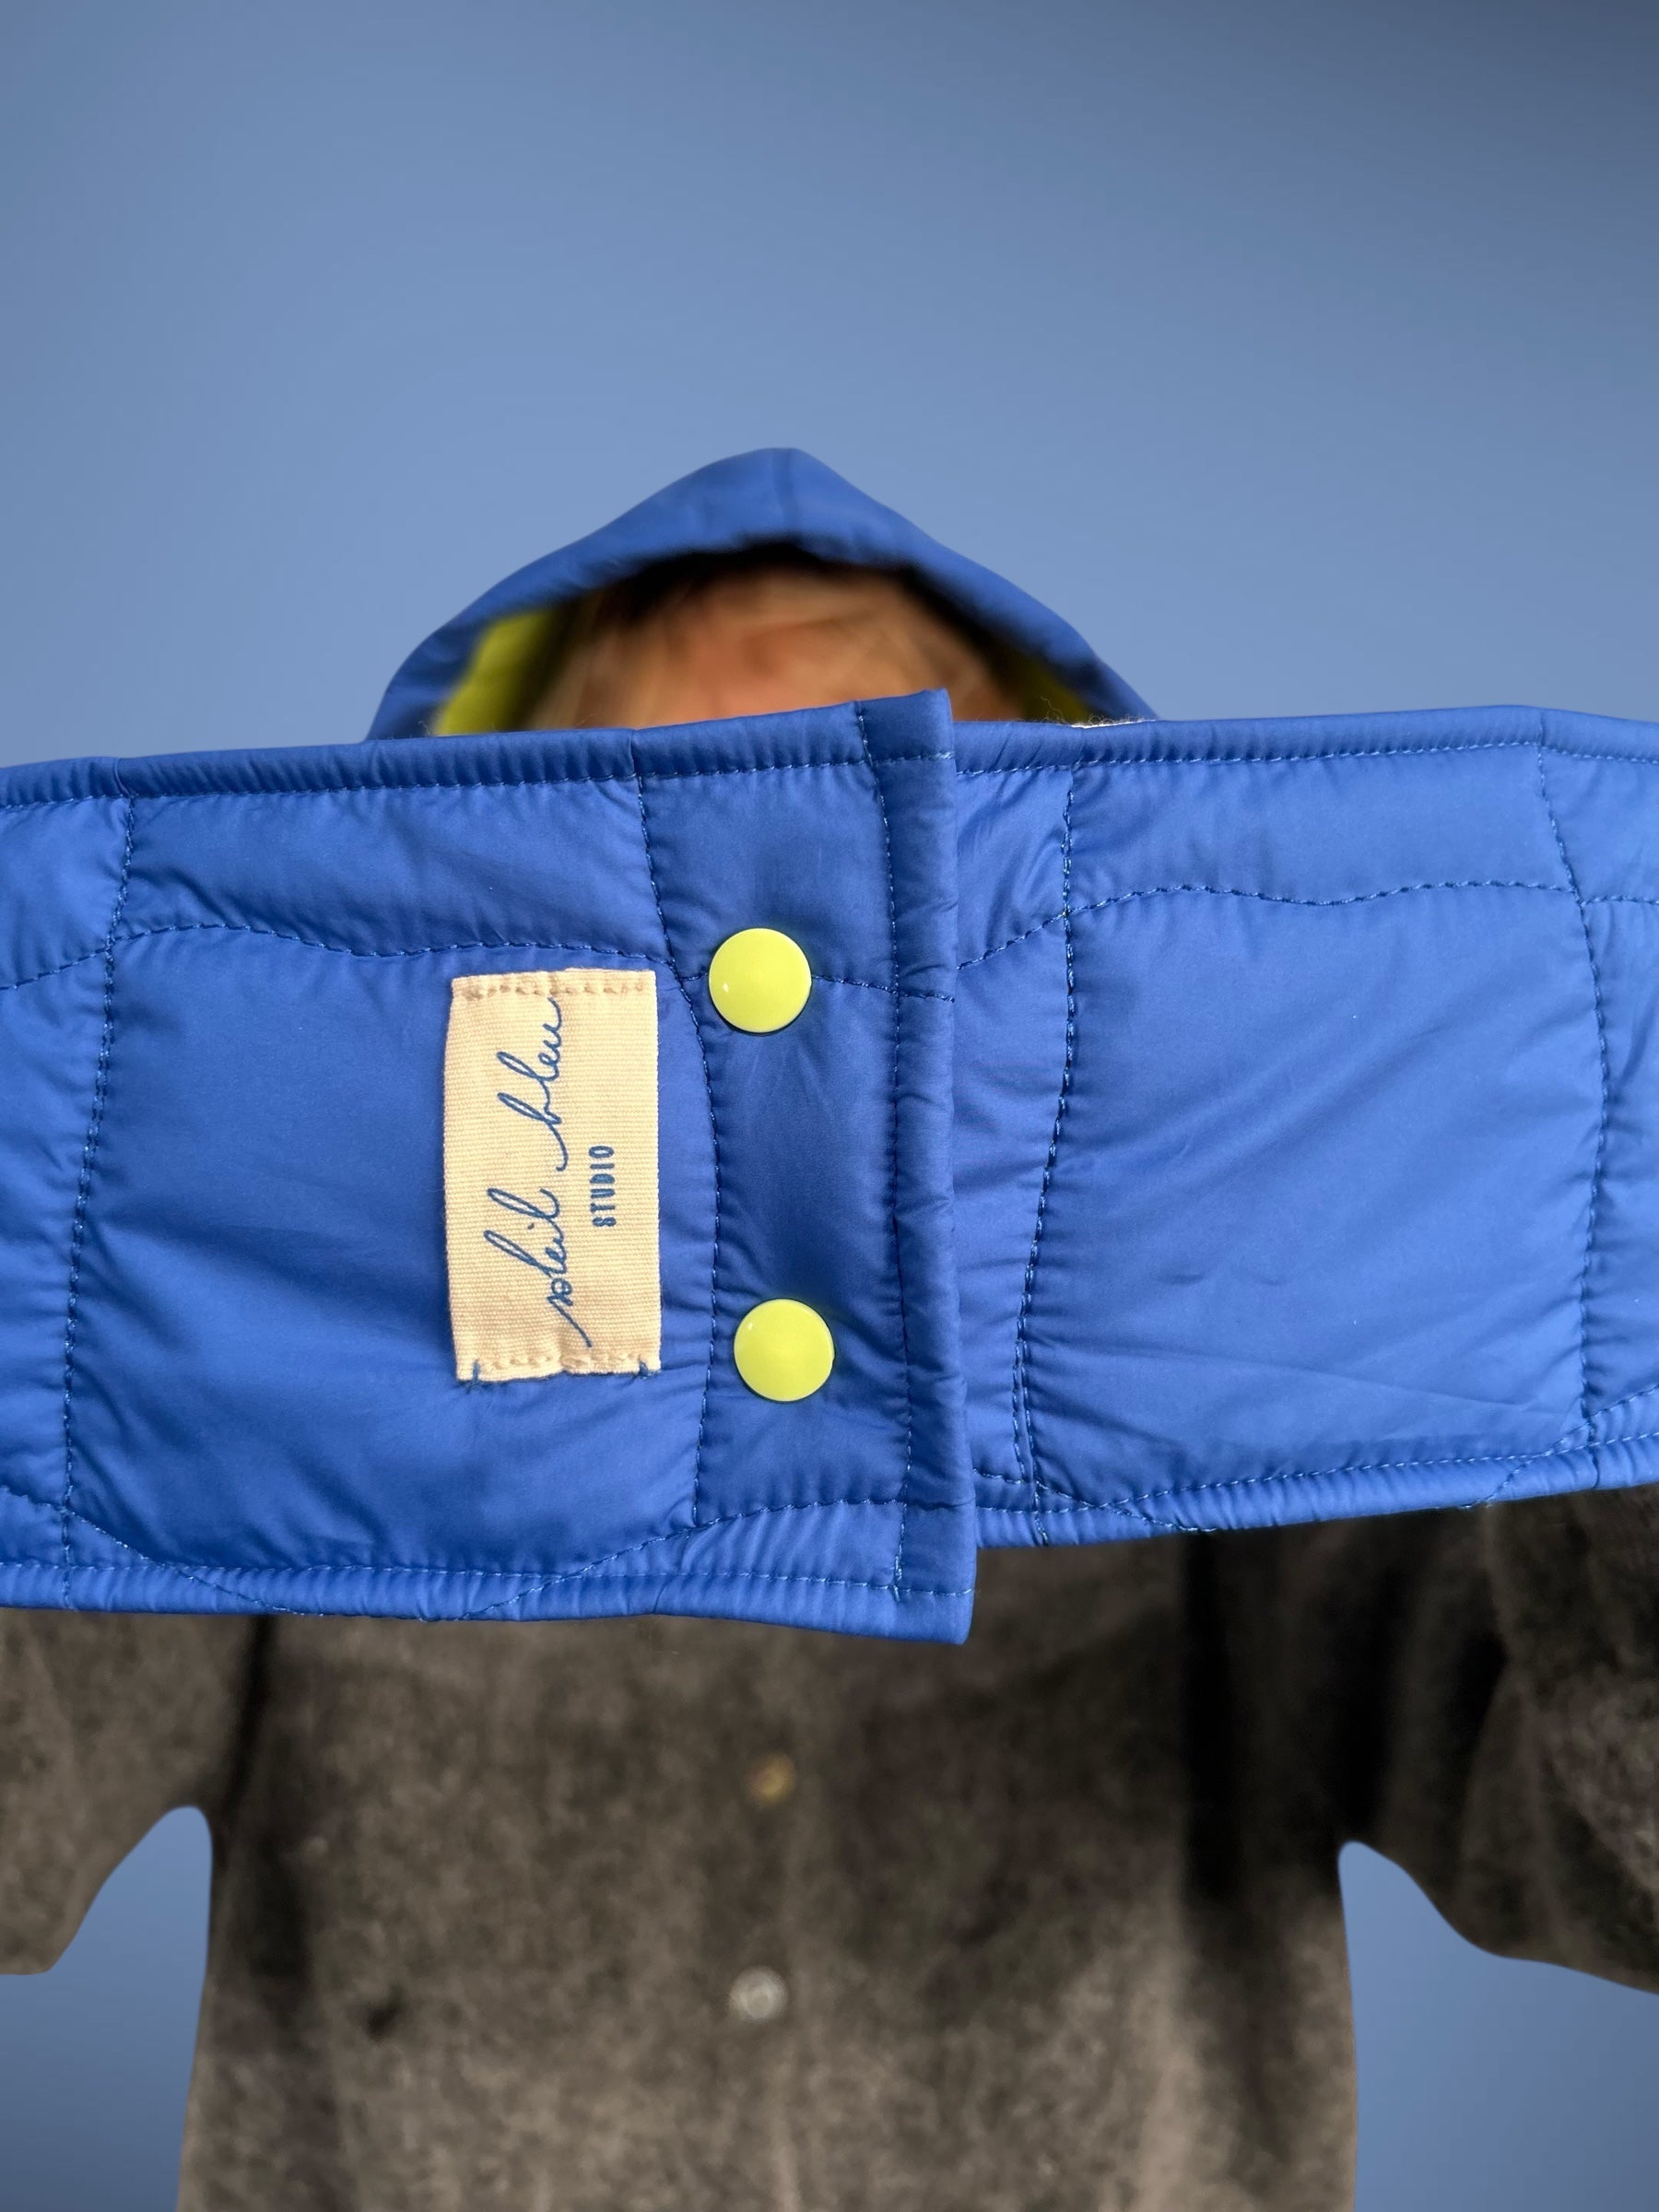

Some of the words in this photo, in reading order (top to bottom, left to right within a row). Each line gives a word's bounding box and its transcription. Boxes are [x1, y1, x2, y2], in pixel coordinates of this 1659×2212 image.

[496, 997, 569, 1172] bleu
[485, 1187, 593, 1348] soleil
[588, 1145, 617, 1229] STUDIO
